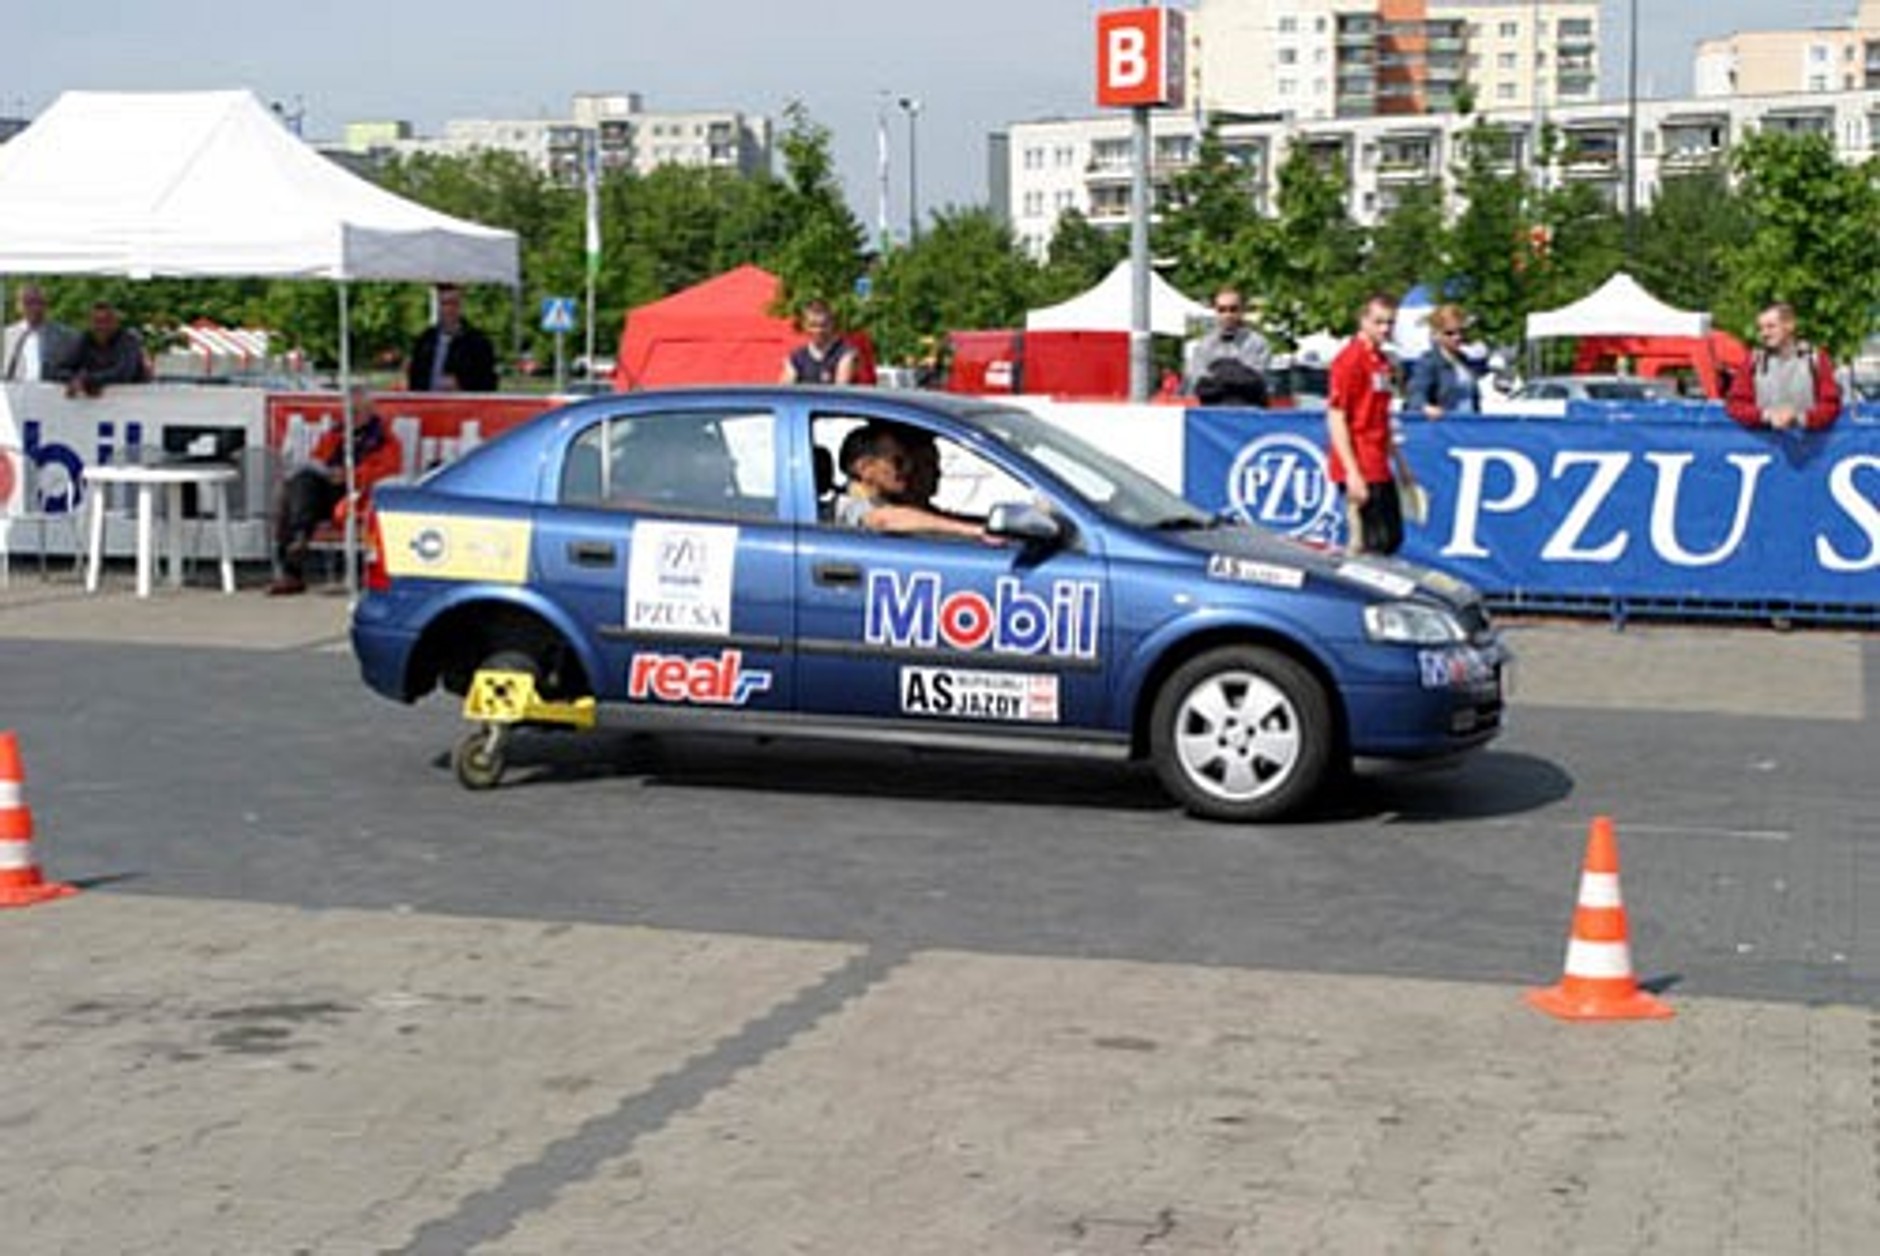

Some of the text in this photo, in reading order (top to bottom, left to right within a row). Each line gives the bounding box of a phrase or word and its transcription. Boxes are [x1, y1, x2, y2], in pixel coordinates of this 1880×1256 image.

[1108, 27, 1148, 89] B
[1243, 451, 1323, 522] PZU
[1441, 446, 1880, 572] PZU S
[634, 600, 686, 625] PZU
[865, 568, 1100, 658] Mobil
[905, 671, 954, 711] AS
